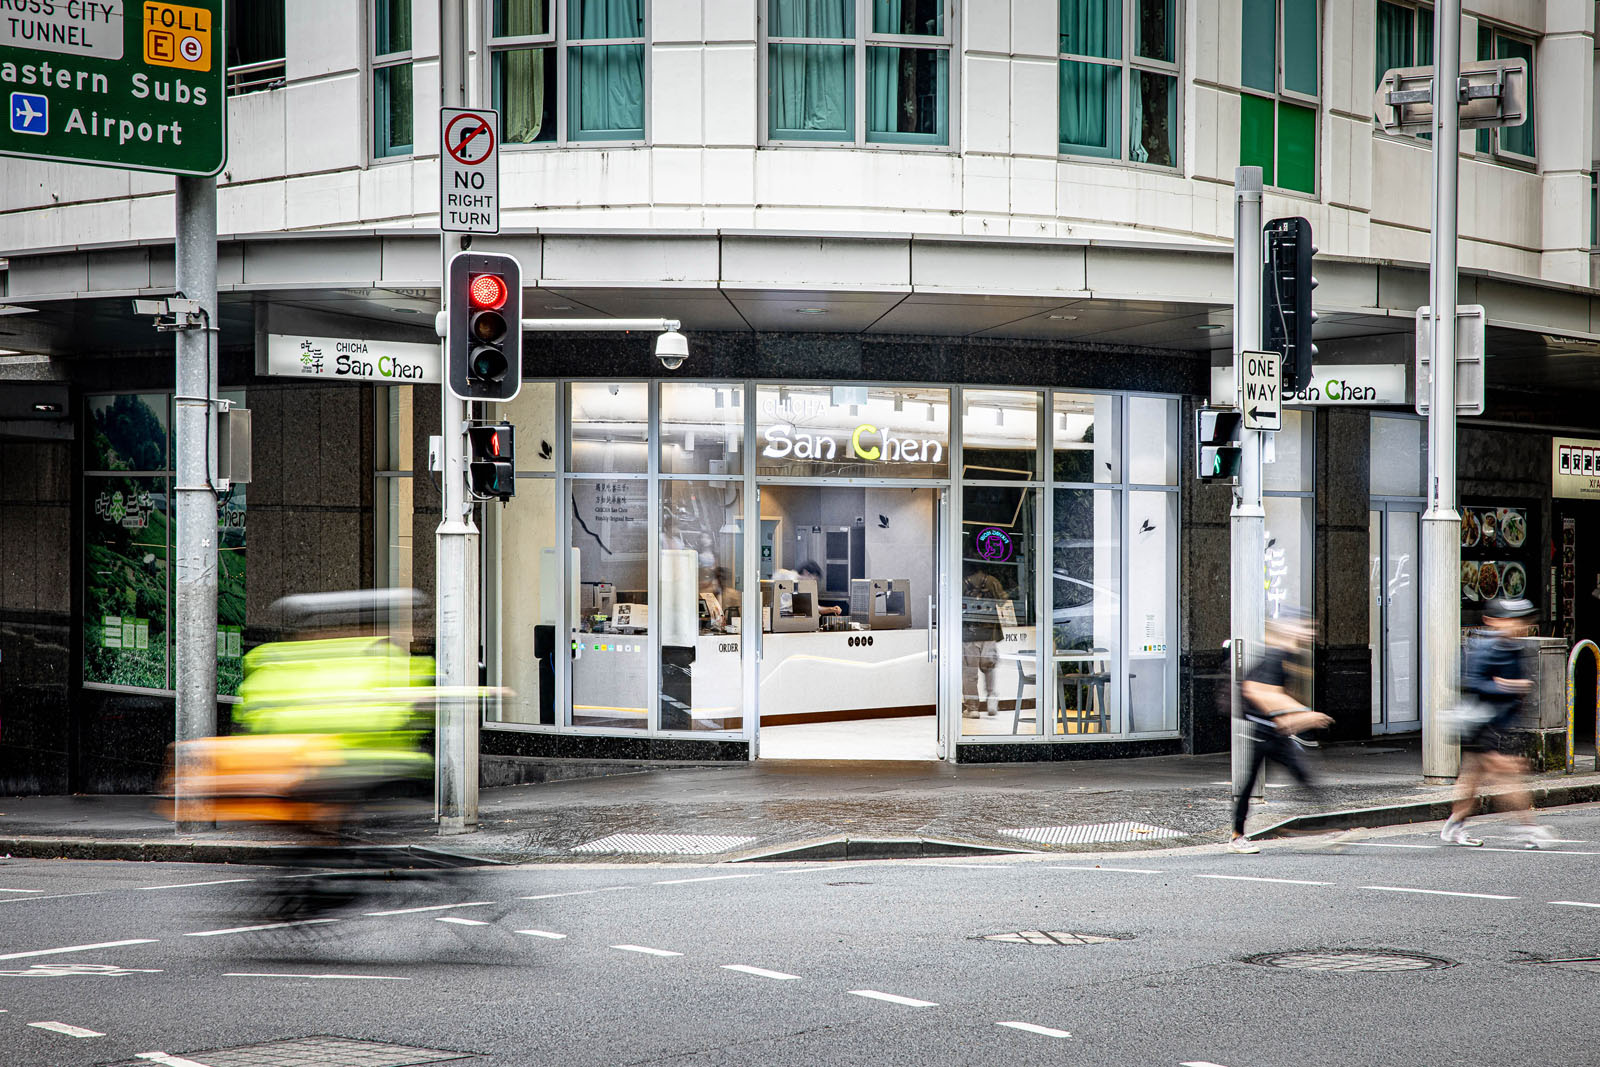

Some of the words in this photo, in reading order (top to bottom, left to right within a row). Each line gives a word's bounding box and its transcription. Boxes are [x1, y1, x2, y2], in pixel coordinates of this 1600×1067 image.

[67, 0, 114, 24] CITY
[146, 6, 207, 33] TOLL
[8, 18, 93, 48] TUNNEL
[154, 34, 169, 57] E
[131, 72, 208, 106] Subs
[64, 108, 183, 145] Airport
[454, 170, 485, 190] NO
[448, 193, 493, 208] RIGHT
[449, 211, 491, 226] TURN
[335, 342, 369, 354] CHICHA
[335, 354, 374, 377] San
[378, 355, 424, 379] Chen
[1248, 358, 1275, 378] ONE
[1246, 382, 1277, 402] WAY
[1325, 379, 1377, 401] Chen
[762, 398, 829, 417] CHICHA
[762, 424, 837, 460] San
[852, 423, 943, 463] Chen
[218, 506, 247, 528] hen
[718, 642, 739, 653] ORDER
[1005, 633, 1018, 642] PICK
[1019, 633, 1028, 641] UP
